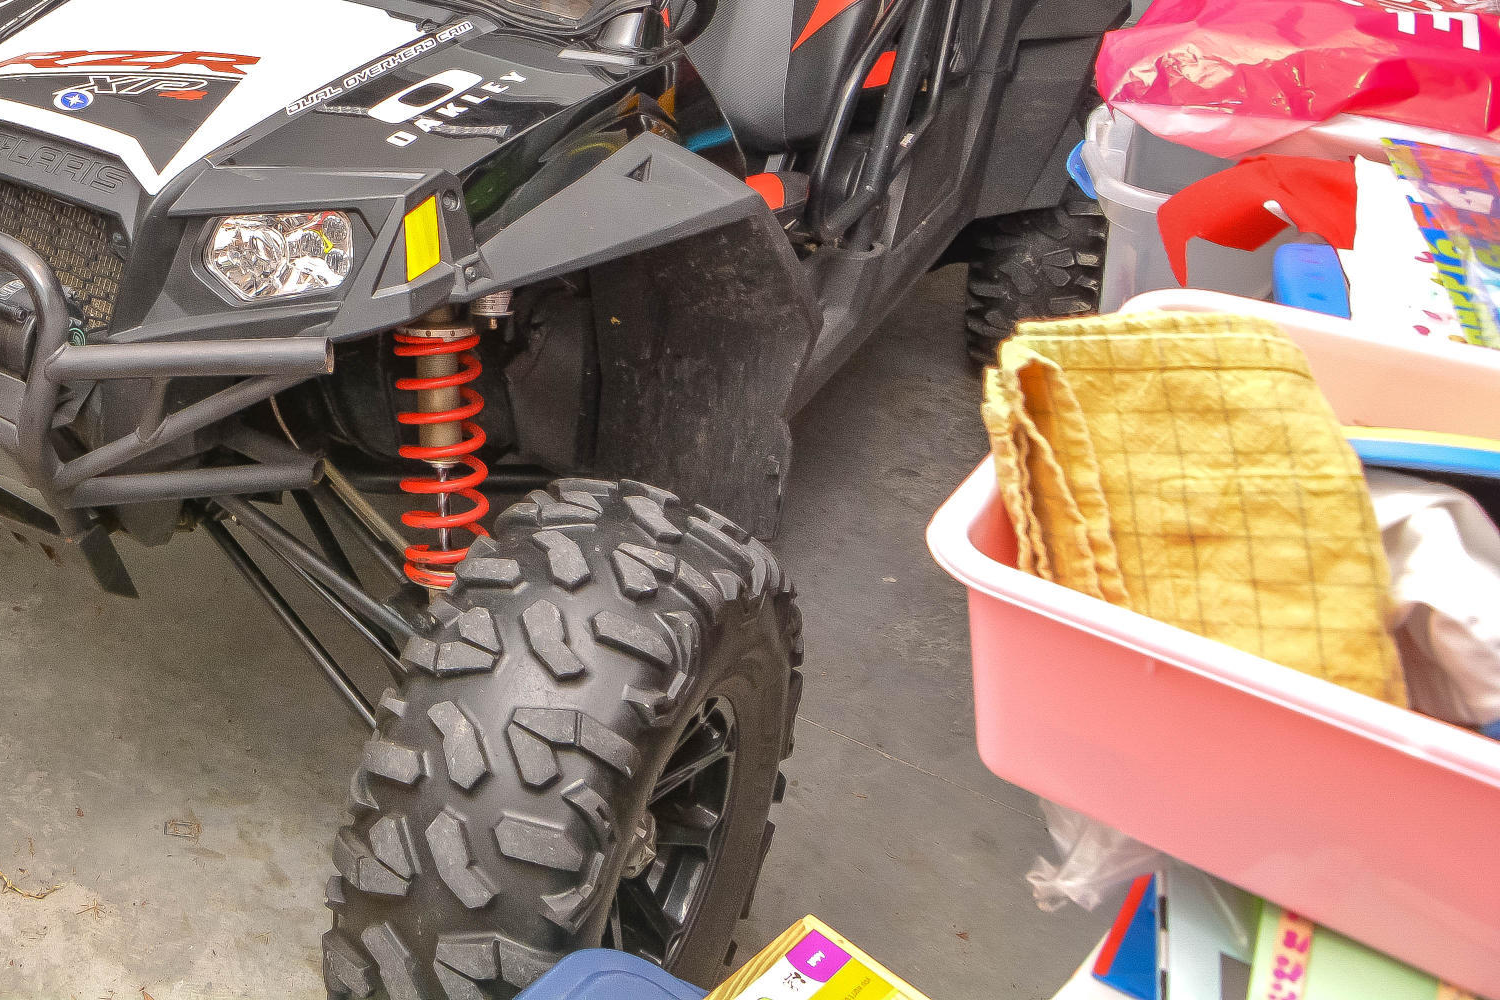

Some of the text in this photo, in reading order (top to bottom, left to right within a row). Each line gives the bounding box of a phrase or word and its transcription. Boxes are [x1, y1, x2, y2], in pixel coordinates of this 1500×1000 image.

[286, 21, 474, 116] DUAL OVERHEAD CAM
[386, 70, 527, 147] OAKLEY
